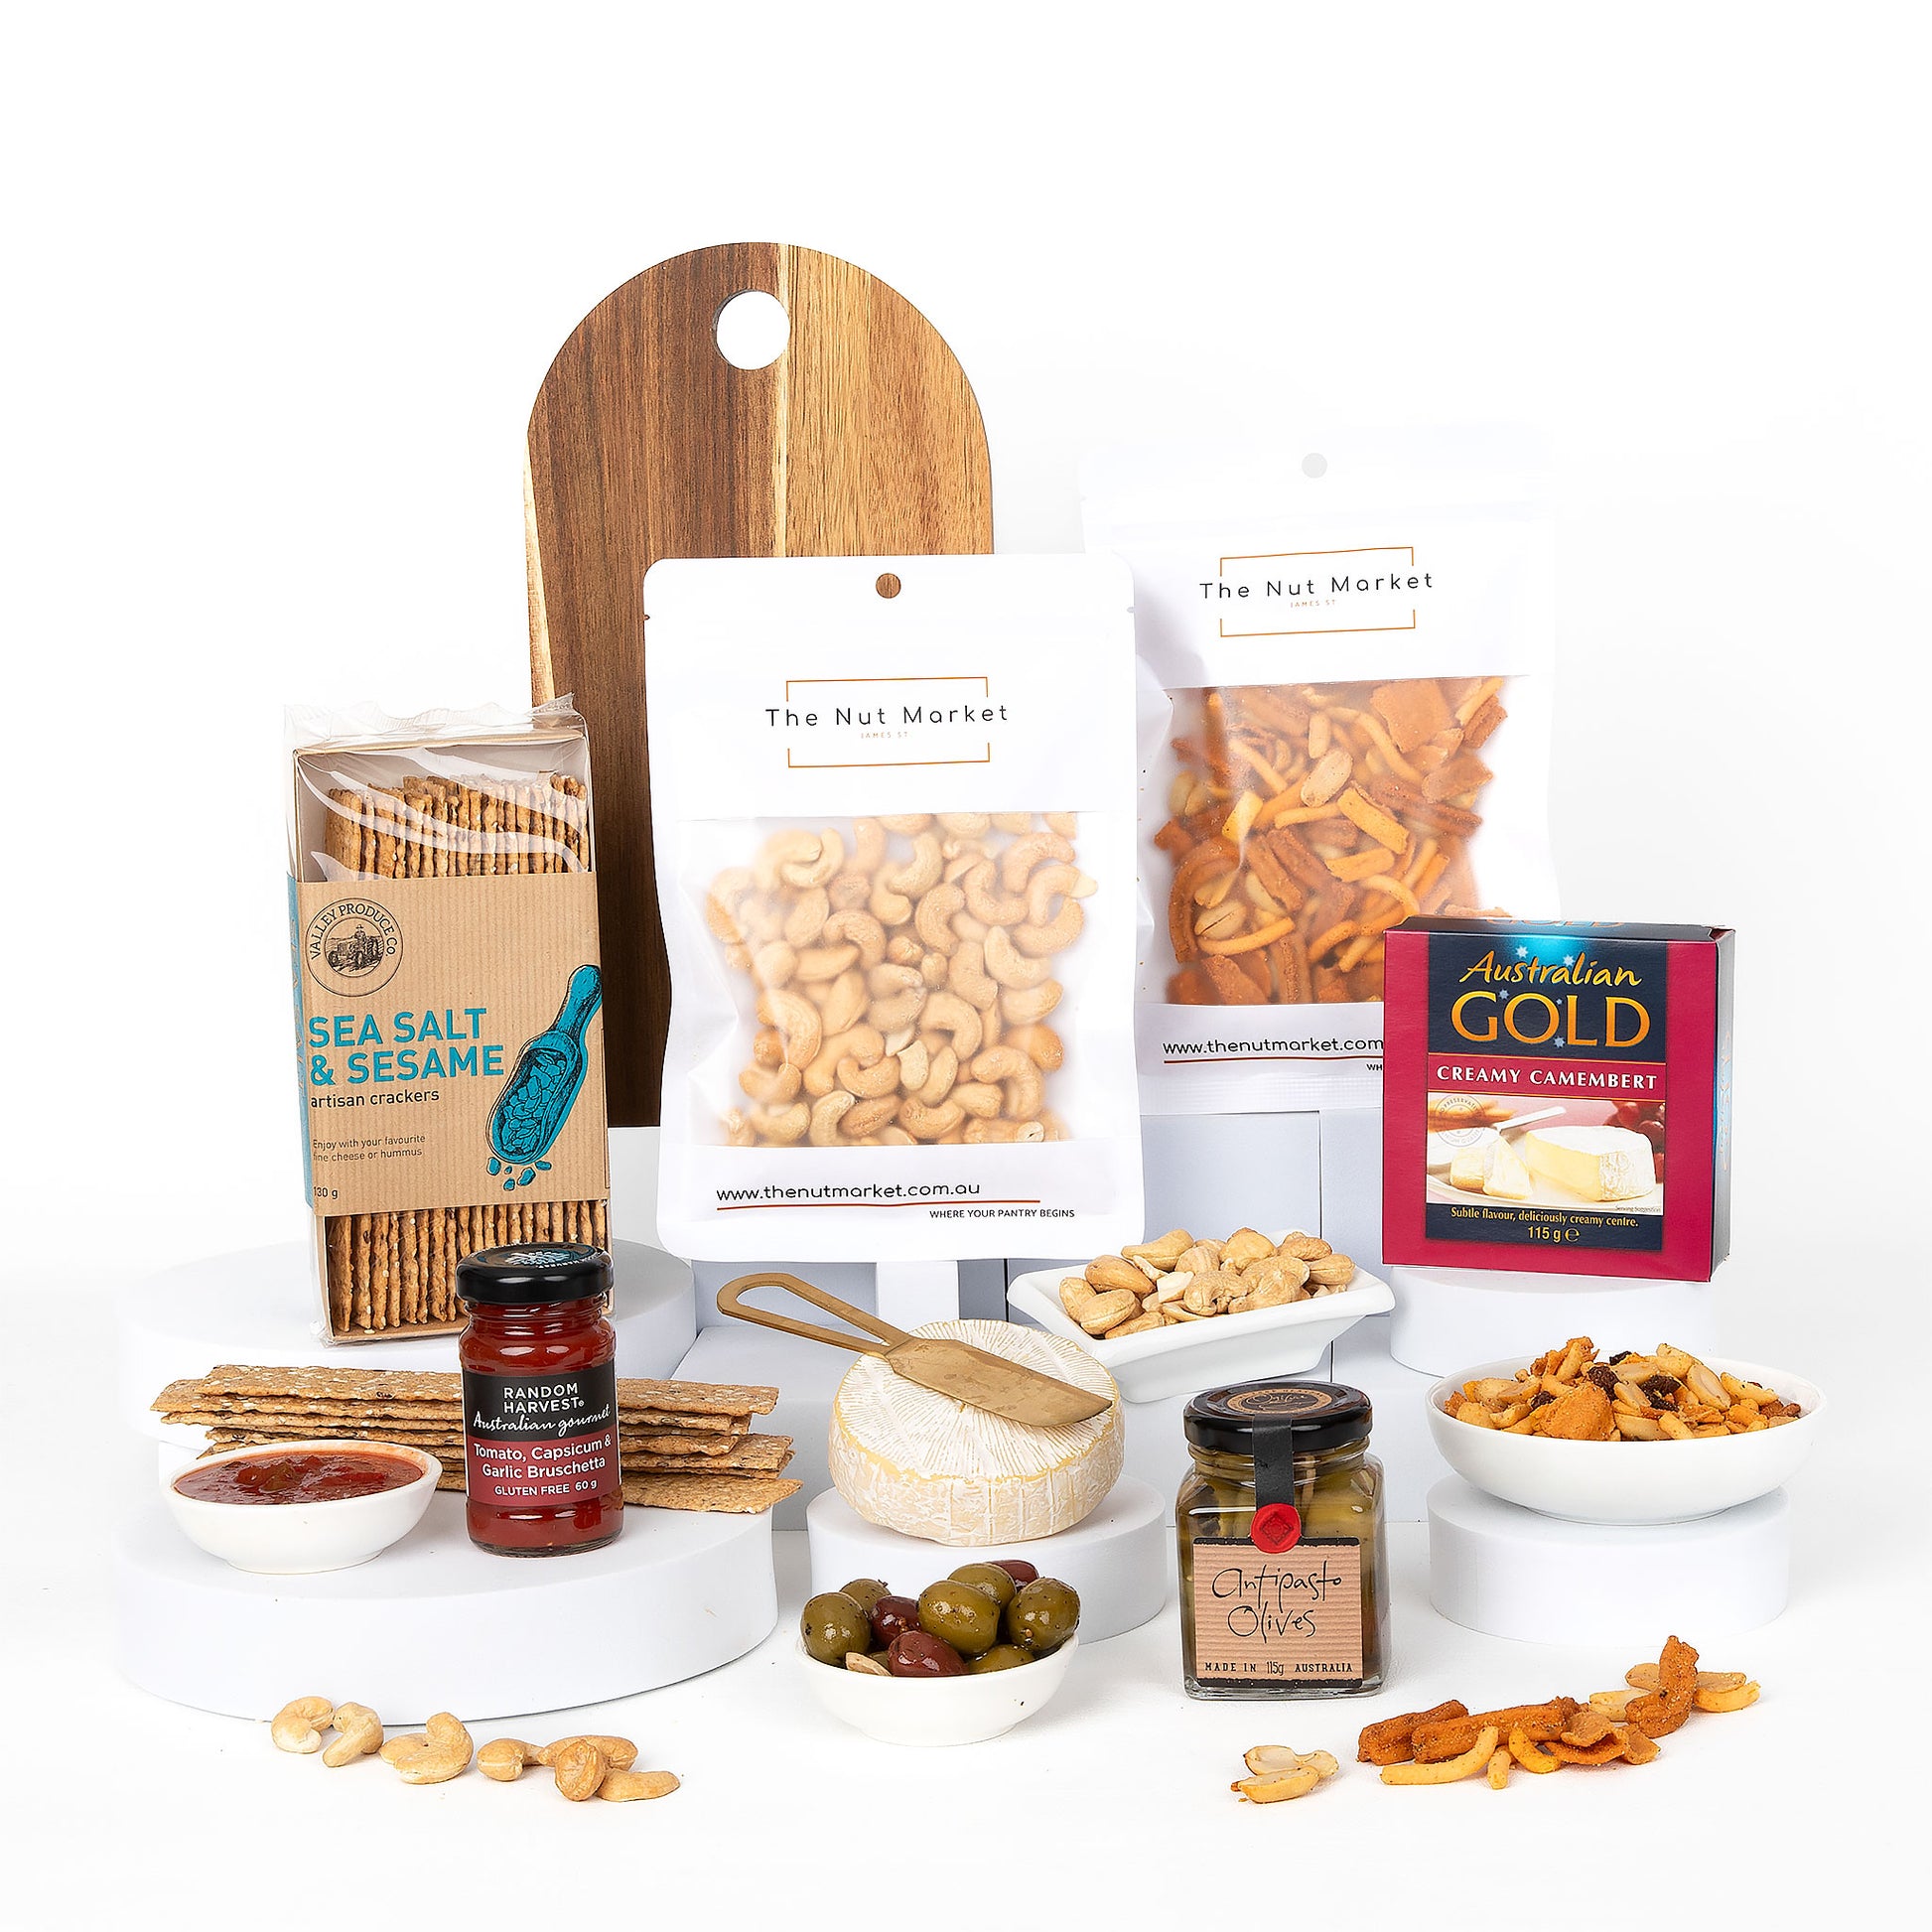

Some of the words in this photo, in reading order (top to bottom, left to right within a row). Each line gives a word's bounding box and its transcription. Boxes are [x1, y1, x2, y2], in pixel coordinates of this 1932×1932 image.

[1198, 582, 1250, 600] The
[1267, 579, 1315, 597] Nut
[1330, 573, 1433, 594] Market
[1290, 600, 1320, 609] JAMES
[764, 708, 819, 727] The
[835, 707, 887, 726] Nut
[902, 704, 1009, 724] Market
[309, 908, 339, 961] VALLEY
[338, 902, 395, 936] PRODUCE
[1458, 950, 1643, 987] Australian
[308, 1014, 383, 1048] SEA
[393, 1008, 487, 1043] SALT
[1450, 990, 1651, 1047] GOLD
[310, 1054, 337, 1086] &
[346, 1044, 504, 1084] SESAME
[1436, 1065, 1521, 1084] CREAMY
[1529, 1069, 1658, 1090] CAMEMBERT
[310, 1093, 365, 1108] artisan
[369, 1089, 440, 1105] crackers
[313, 1139, 338, 1152] Enjoy
[339, 1138, 359, 1149] with
[360, 1138, 382, 1150] your
[384, 1134, 426, 1146] favourite
[331, 1152, 365, 1162] cheese
[367, 1151, 378, 1160] or
[380, 1148, 423, 1159] hummus
[313, 1185, 329, 1197] 130
[331, 1188, 339, 1200] g
[716, 1181, 981, 1201] www.thenutmarket.com.au
[929, 1209, 965, 1219] WHERE
[967, 1209, 996, 1218] YOUR
[997, 1208, 1037, 1218] PANTRY
[1039, 1208, 1075, 1218] BEGINS
[1450, 1206, 1480, 1219] Subtle
[1481, 1207, 1516, 1222] flavour,
[1518, 1210, 1568, 1225] deliciously
[1569, 1214, 1604, 1228] creamy
[1605, 1215, 1639, 1228] centre.
[1527, 1225, 1550, 1240] 115
[1553, 1230, 1561, 1243] g
[503, 1382, 578, 1399] RANDOM
[473, 1410, 557, 1431] Australian
[557, 1403, 612, 1437] gourmet
[473, 1443, 527, 1463] Tomato,
[530, 1439, 603, 1461] Capsicum
[604, 1434, 612, 1448] &
[482, 1462, 523, 1479] Garlic
[526, 1455, 606, 1479] Bruschetta
[494, 1485, 538, 1496] GLUTEN
[540, 1483, 570, 1496] FREE
[575, 1479, 589, 1491] 60
[590, 1479, 598, 1490] g
[1227, 1600, 1316, 1644] Olives
[1204, 1662, 1237, 1673] MADE
[1243, 1662, 1257, 1673] IN
[1266, 1661, 1285, 1677] 115g
[1294, 1662, 1353, 1673] AUSTRALIA
